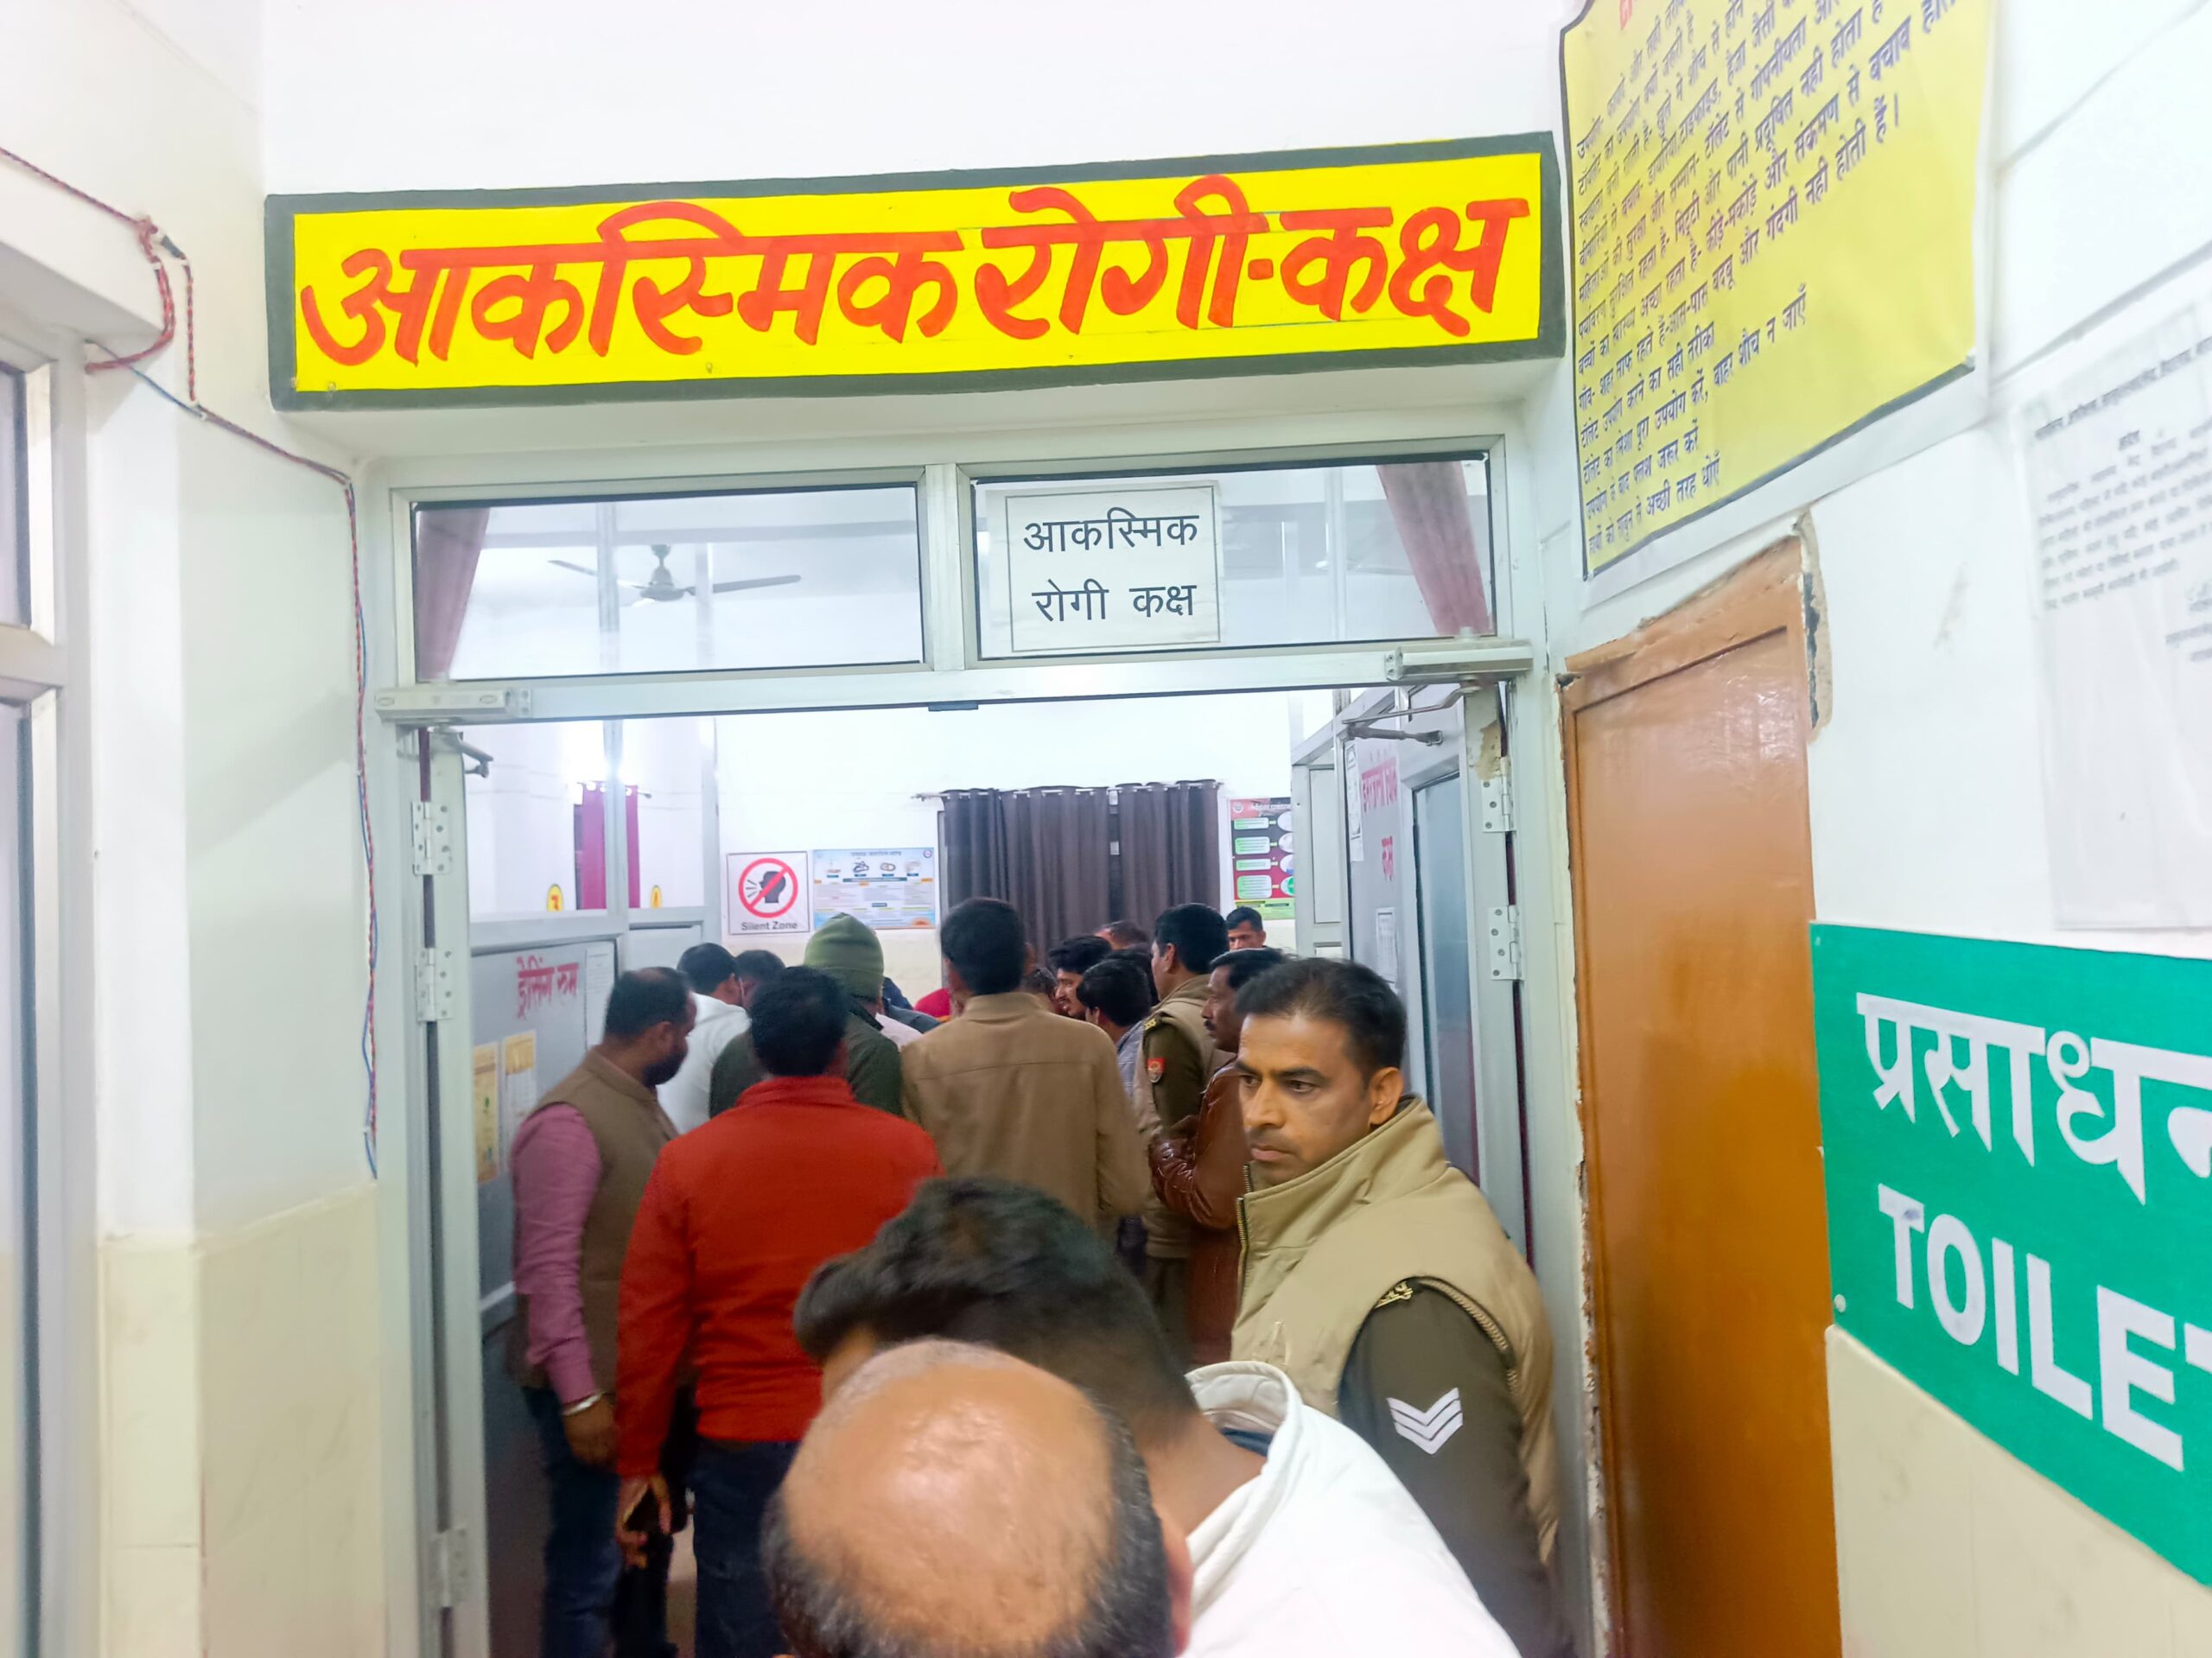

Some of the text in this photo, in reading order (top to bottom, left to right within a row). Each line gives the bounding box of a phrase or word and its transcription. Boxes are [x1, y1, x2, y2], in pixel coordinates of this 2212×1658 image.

[1726, 130, 1748, 179] पानी
[1830, 7, 1862, 68] होता
[1734, 86, 1745, 123] से
[1750, 16, 1806, 99] गोपनीयता
[1599, 333, 1609, 356] का
[1665, 256, 1686, 291] रहता
[1765, 148, 1788, 189] और
[1846, 63, 1859, 106] से
[1868, 16, 1910, 79] बचाव
[301, 201, 963, 366] आकस्मिक
[1636, 325, 1654, 361] रहते
[1712, 254, 1734, 290] बदबू
[1739, 226, 1759, 264] और
[1765, 185, 1798, 239] गंदगी
[1834, 117, 1866, 180] होती
[1626, 372, 1644, 408] करने
[1649, 365, 1662, 391] का
[1667, 341, 1683, 380] सही
[1687, 321, 1714, 359] तरीका
[1654, 389, 1686, 429] उपयोग
[1713, 352, 1732, 385] बाहर
[1738, 327, 1760, 364] शौच
[1765, 316, 1776, 342] न
[1682, 417, 1698, 453] करें
[1023, 507, 1199, 552] आकस्मिक
[1646, 479, 1670, 515] अच्छी
[1675, 472, 1696, 501] तरह
[1032, 578, 1197, 621] रोगी कक्ष
[741, 921, 798, 931] Silent Zone
